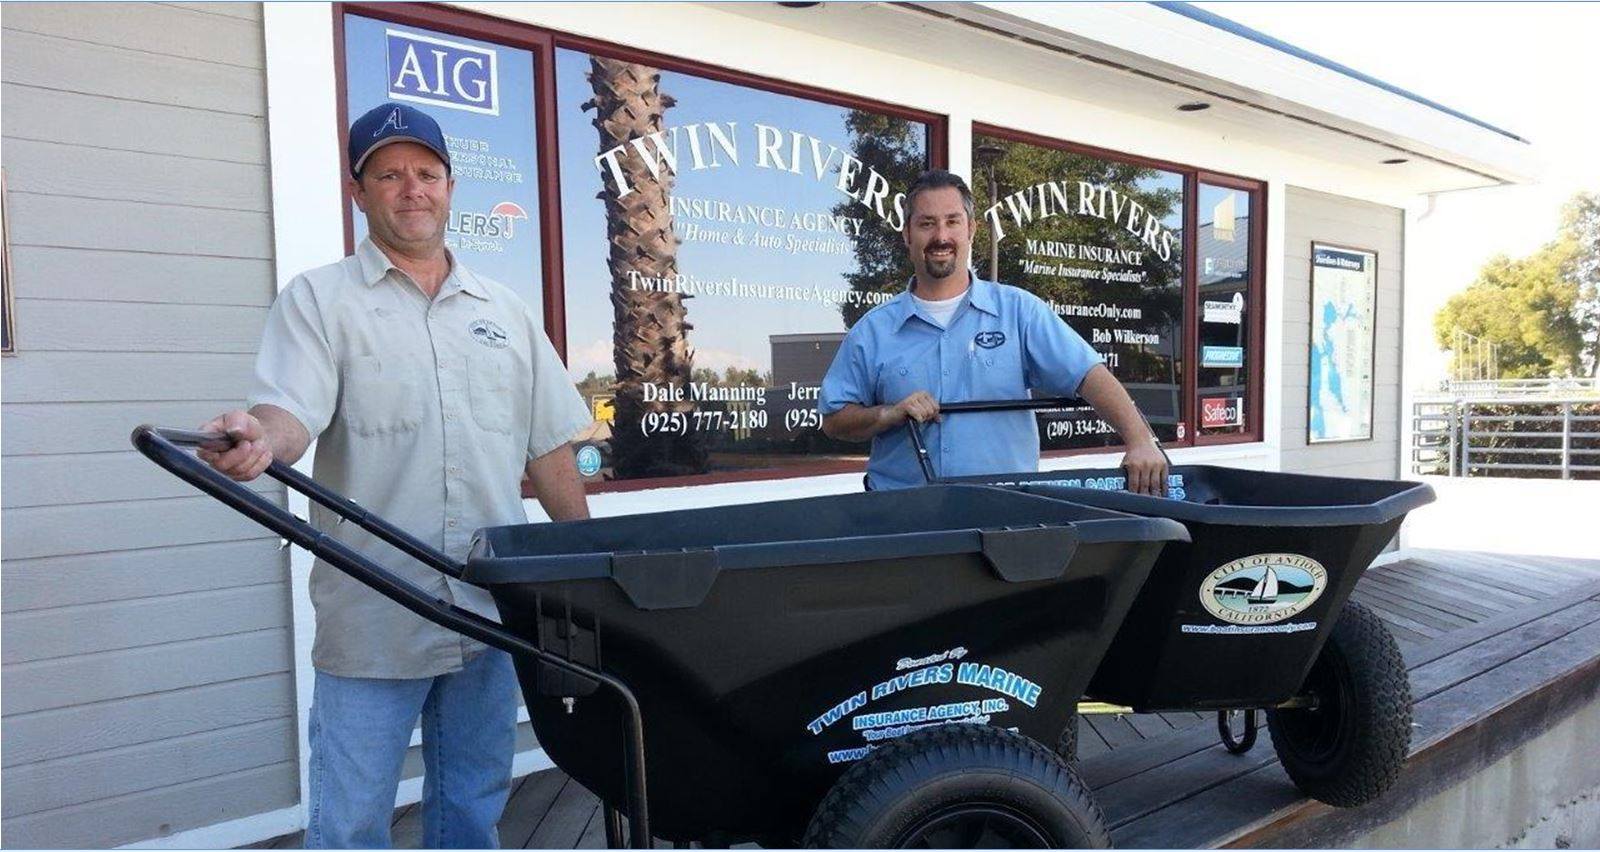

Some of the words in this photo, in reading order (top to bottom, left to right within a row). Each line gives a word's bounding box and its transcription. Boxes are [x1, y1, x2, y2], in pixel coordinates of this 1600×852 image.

[394, 43, 487, 102] AIG
[448, 150, 516, 169] ERSONAL
[451, 166, 523, 183] SURANCE
[594, 121, 740, 199] TWIN
[754, 123, 907, 232] RIVERS
[446, 211, 501, 237] LERS
[669, 196, 785, 228] INSURANCE
[790, 211, 864, 236] AGENCY
[984, 180, 1070, 241] TWIN
[1079, 181, 1175, 260] RIVERS
[676, 221, 729, 244] "Home
[733, 229, 745, 245] &
[749, 233, 781, 249] Auto
[784, 234, 858, 256] Specialists"
[1026, 239, 1076, 259] MARINE
[1080, 244, 1143, 266] INSURANCE
[1020, 259, 1057, 277] "Marine
[1059, 263, 1100, 280] Insurance
[1102, 266, 1147, 284] Specialists"
[626, 270, 893, 306] TwinRiversInsuranceAgency.com
[1092, 328, 1111, 343] Bob
[1113, 328, 1160, 345] Wilkerson
[642, 382, 684, 402] Dale
[689, 382, 766, 404] Manning
[788, 381, 821, 401] Jerr
[641, 411, 687, 437] (925)
[693, 409, 768, 431] 777-2180
[785, 408, 823, 432] (925)
[1204, 403, 1236, 423] Safeco
[1047, 421, 1073, 440] (209)
[1075, 418, 1117, 436] 334-285
[1085, 476, 1126, 490] CART
[1213, 561, 1246, 580] CITY
[1252, 557, 1268, 565] OF
[1274, 557, 1325, 580] ANTIOCH
[1218, 606, 1297, 622] CALIFORNIA
[807, 691, 867, 735] TWIN
[871, 663, 954, 700] RIVERS
[956, 662, 1042, 708] MARINE
[853, 708, 927, 730] INSURANCE
[928, 701, 980, 720] AGENCY,
[982, 698, 1009, 714] INC.
